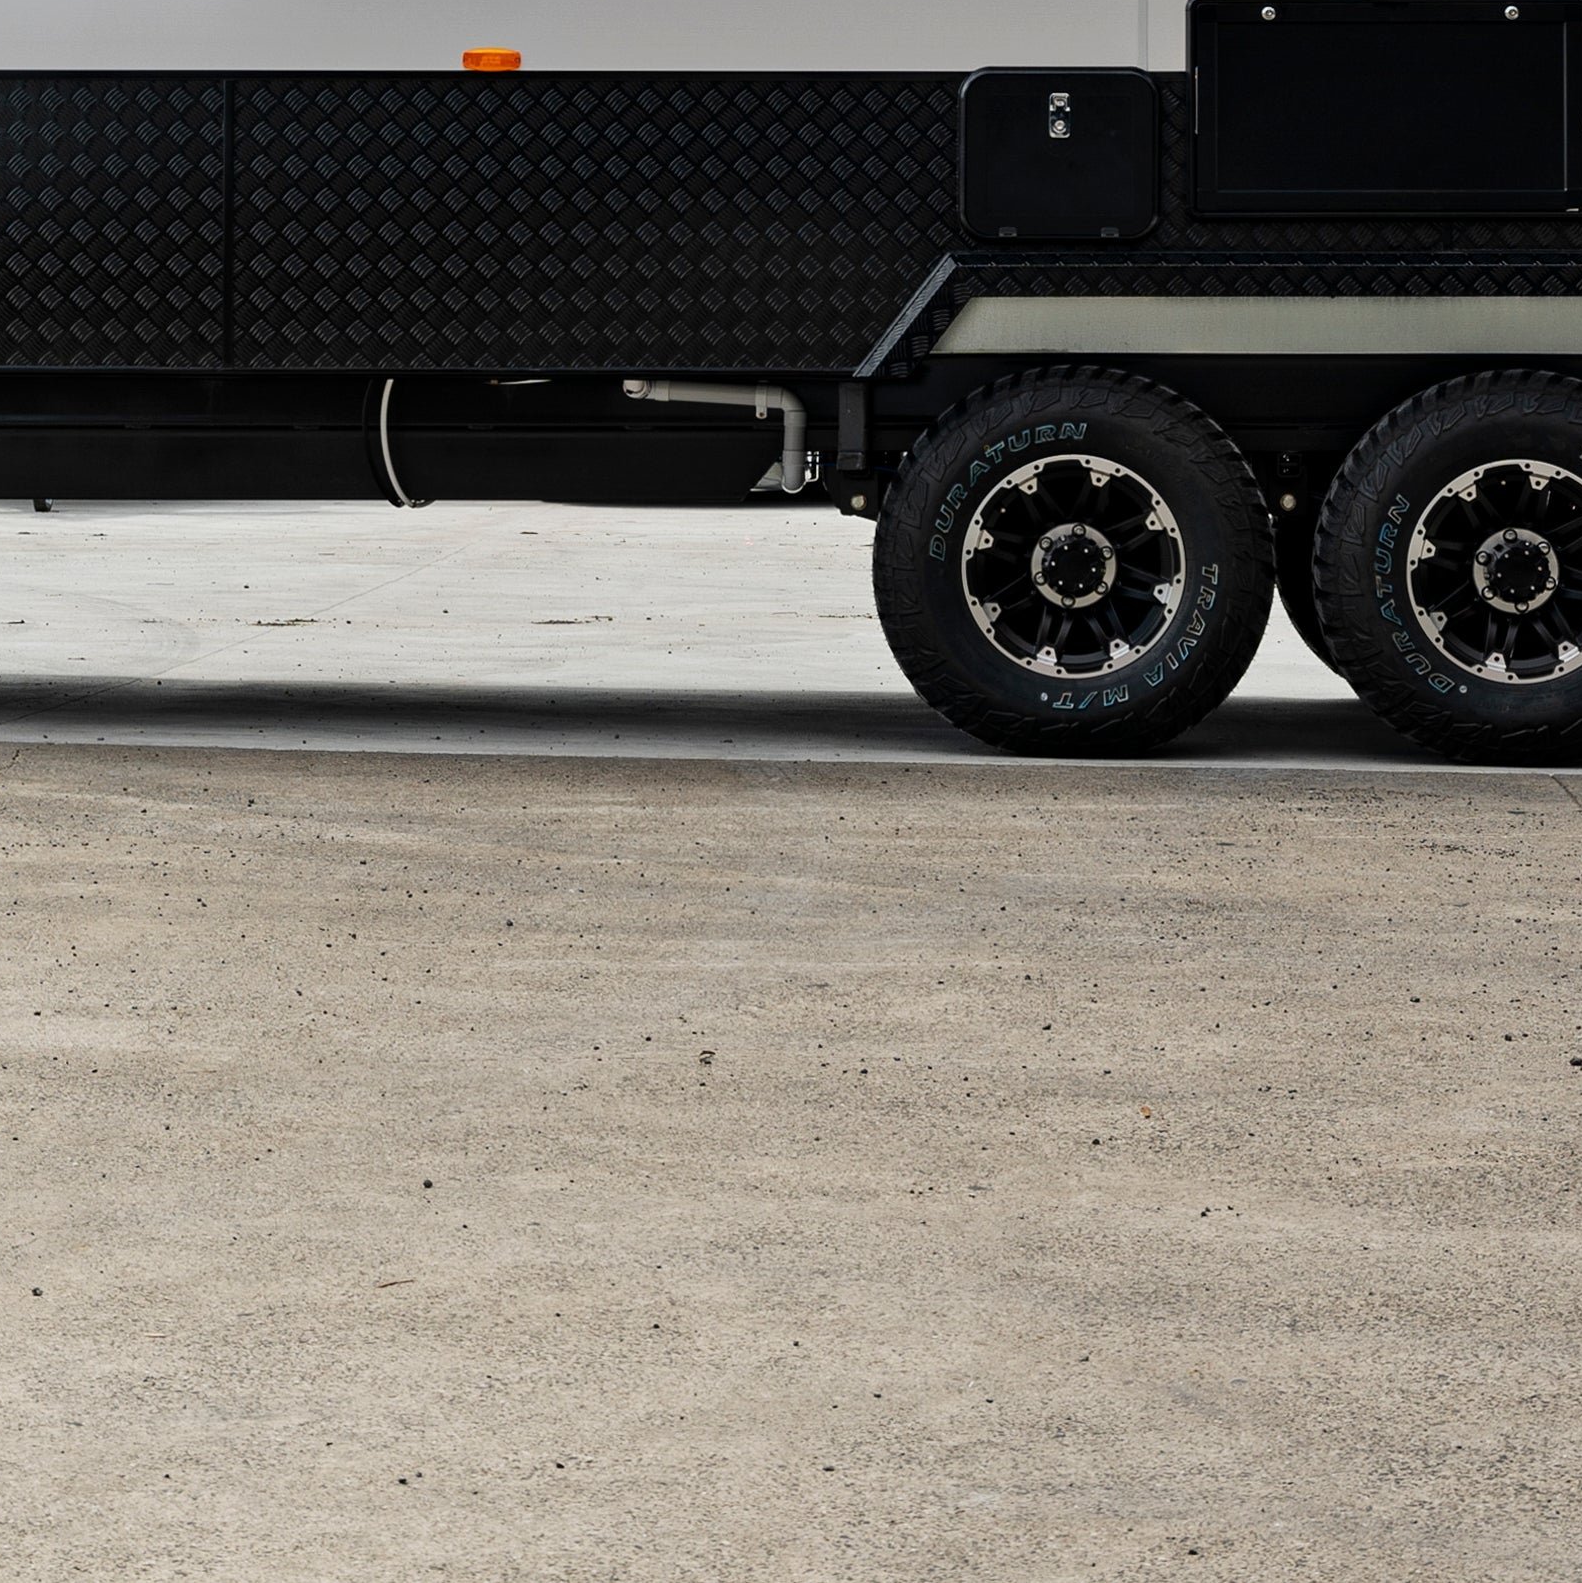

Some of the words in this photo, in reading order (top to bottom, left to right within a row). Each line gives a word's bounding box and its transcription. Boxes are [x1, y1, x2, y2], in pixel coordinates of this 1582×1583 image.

[929, 422, 1088, 562] DURATURN
[1142, 562, 1219, 688] TRAVIA
[1374, 493, 1457, 695] DURATURN
[1051, 683, 1130, 710] M/T
